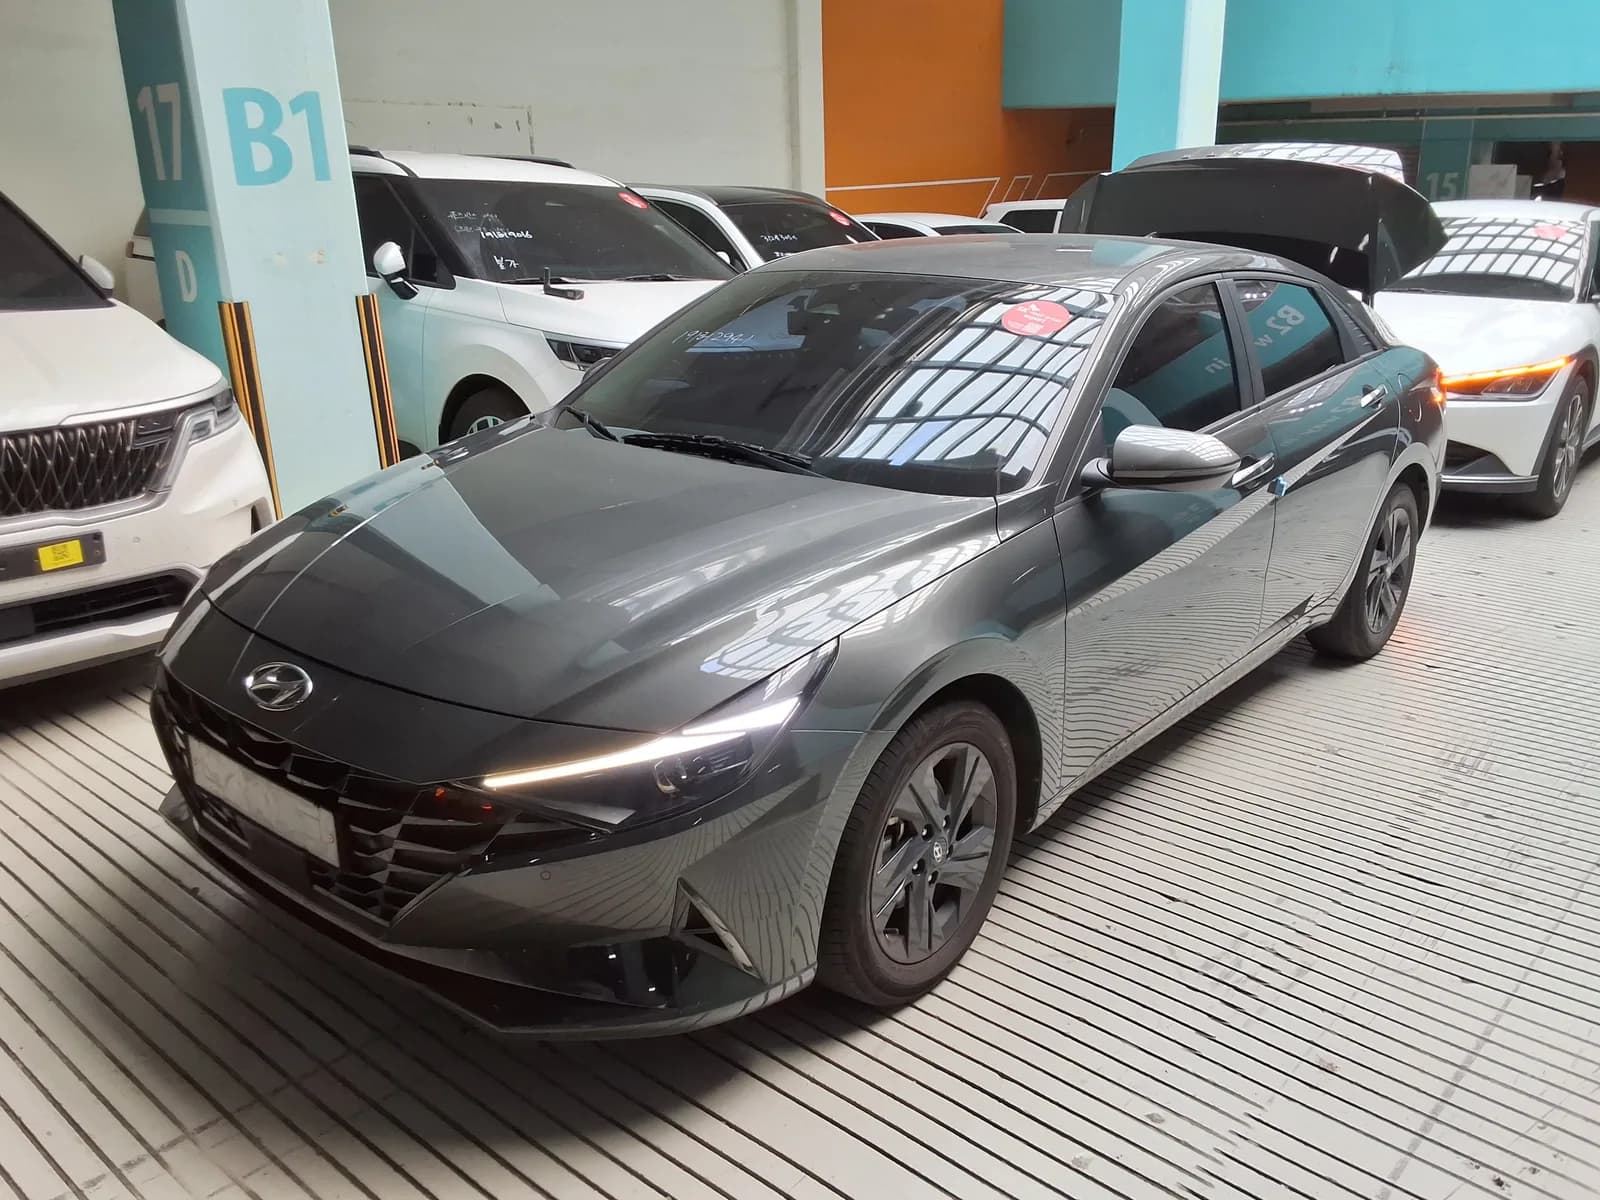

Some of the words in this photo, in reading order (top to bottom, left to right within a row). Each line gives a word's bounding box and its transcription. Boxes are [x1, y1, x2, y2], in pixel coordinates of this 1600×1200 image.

[137, 82, 182, 181] 17
[222, 87, 331, 187] B1
[1426, 172, 1459, 200] 15
[175, 250, 198, 303] D
